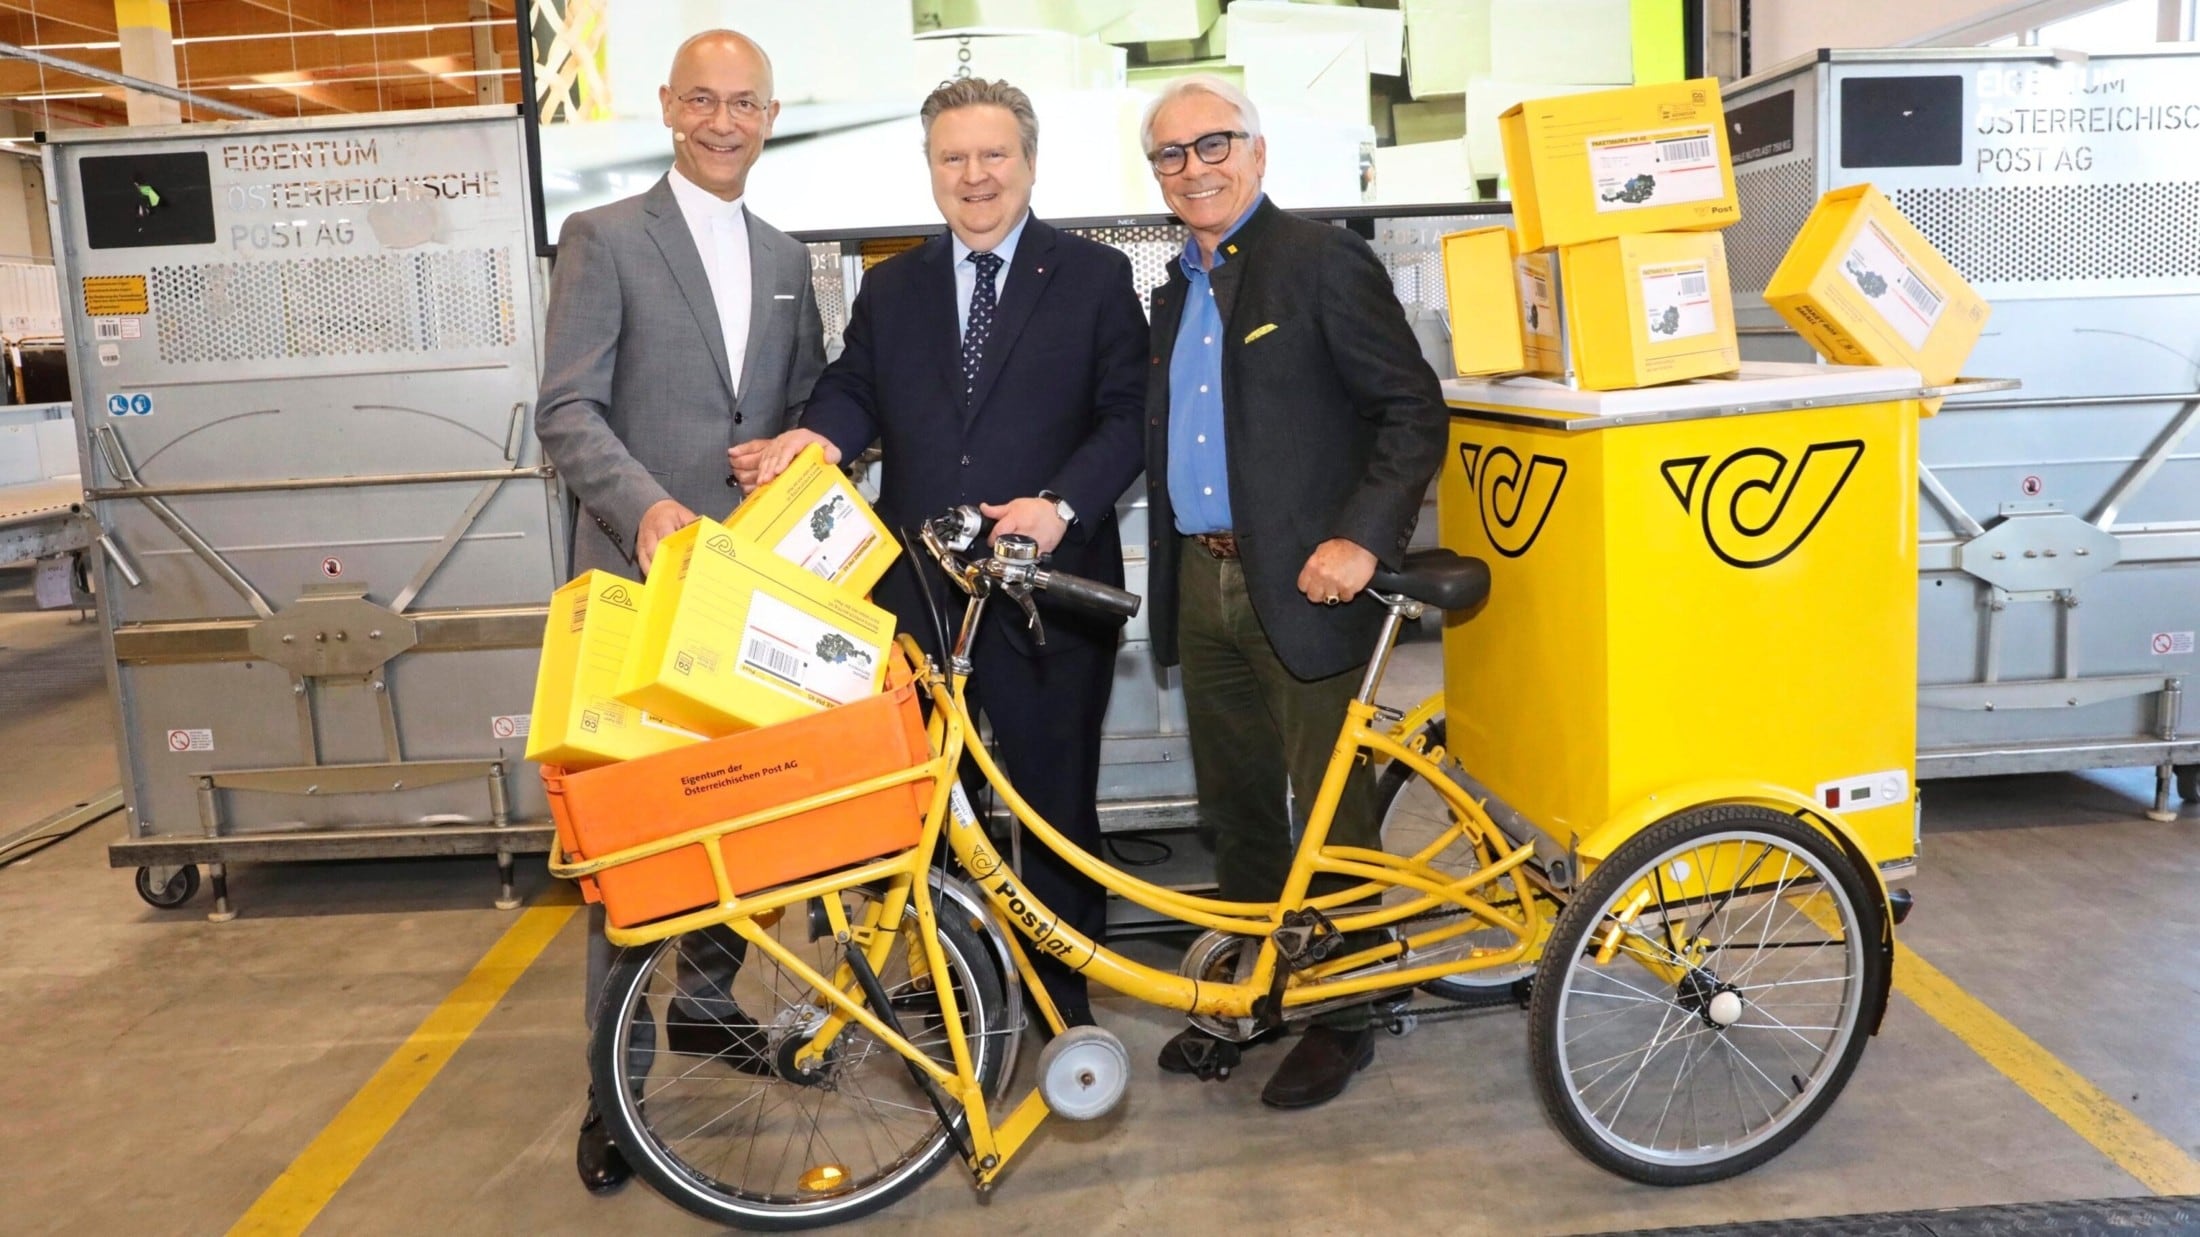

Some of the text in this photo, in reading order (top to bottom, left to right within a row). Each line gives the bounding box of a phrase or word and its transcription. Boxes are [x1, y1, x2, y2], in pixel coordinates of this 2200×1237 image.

[223, 139, 379, 171] EIGENTUM
[1977, 146, 2093, 173] POST AG
[1711, 205, 1733, 214] Post
[231, 218, 355, 250] POST AG
[680, 763, 743, 785] Eigentum der
[684, 760, 798, 796] Österreichischen Post AG
[994, 879, 1074, 958] Post at
